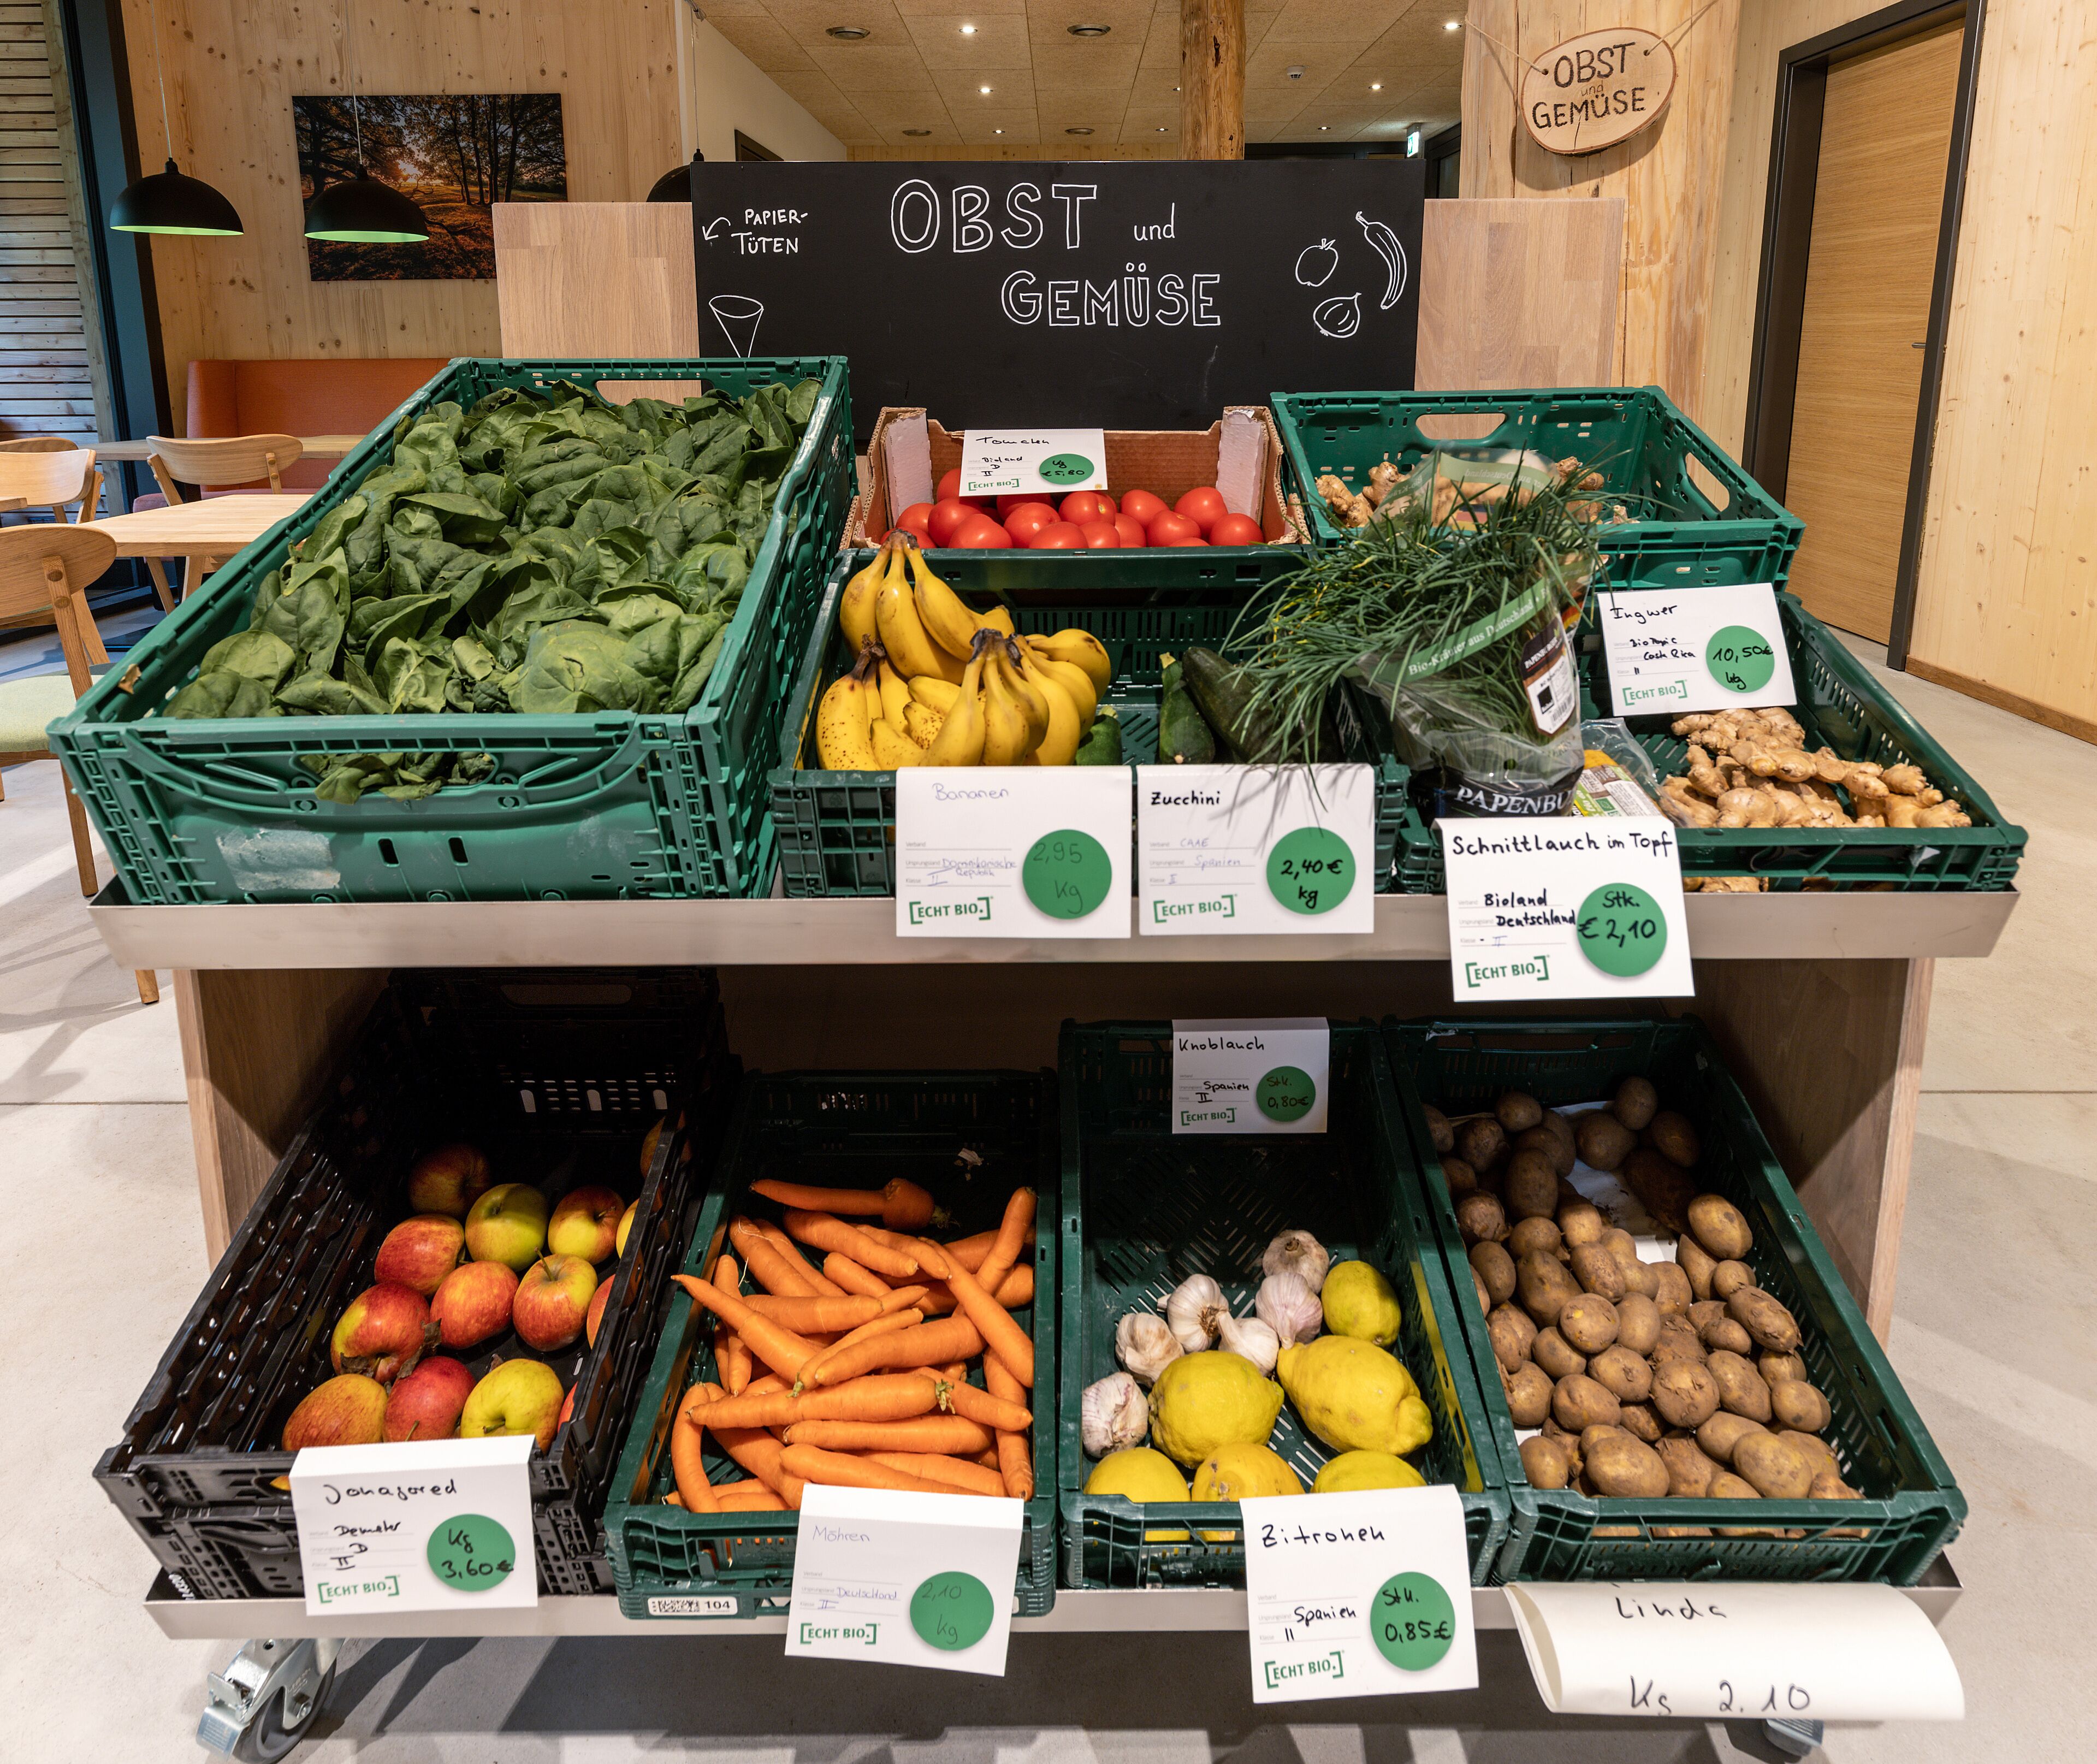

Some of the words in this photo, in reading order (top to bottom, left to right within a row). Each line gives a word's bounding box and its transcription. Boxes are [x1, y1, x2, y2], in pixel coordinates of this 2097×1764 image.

[1554, 42, 1636, 88] OBST
[1581, 80, 1604, 97] und
[1532, 87, 1646, 129] GEMÜSE
[744, 208, 808, 226] PAPIER-
[891, 179, 1097, 253] OBST
[1134, 202, 1175, 241] und
[731, 230, 799, 255] TÜTEN
[1000, 262, 1221, 328] GEMÜSE
[975, 436, 1050, 445] Tomaten
[1468, 631, 1485, 647] aus
[1485, 599, 1534, 637] Dutschland
[1610, 605, 1678, 624] Ingwer
[932, 782, 1009, 802] Bananen
[1151, 790, 1221, 806] Zucchini
[1033, 841, 1083, 865] 2,95
[1452, 832, 1600, 855] Schnittlauch
[1607, 835, 1625, 849] im
[1629, 830, 1673, 857] Topf
[1194, 854, 1241, 872] Spanien
[1298, 885, 1318, 909] kg
[1483, 887, 1548, 908] Bioland
[1602, 890, 1640, 908] Stk.
[1495, 908, 1576, 928] Deutschland
[1179, 1036, 1264, 1051] Knoblauch
[1203, 1081, 1249, 1093] Spanien
[322, 1479, 458, 1505] Jonagored
[812, 1525, 871, 1542] Möhren
[1261, 1524, 1385, 1548] Zitronen
[348, 1542, 369, 1554] D
[922, 1582, 962, 1602] 2,10
[704, 1601, 731, 1609] 104
[1615, 1596, 1727, 1620] Linda
[1294, 1605, 1356, 1627] Spanien
